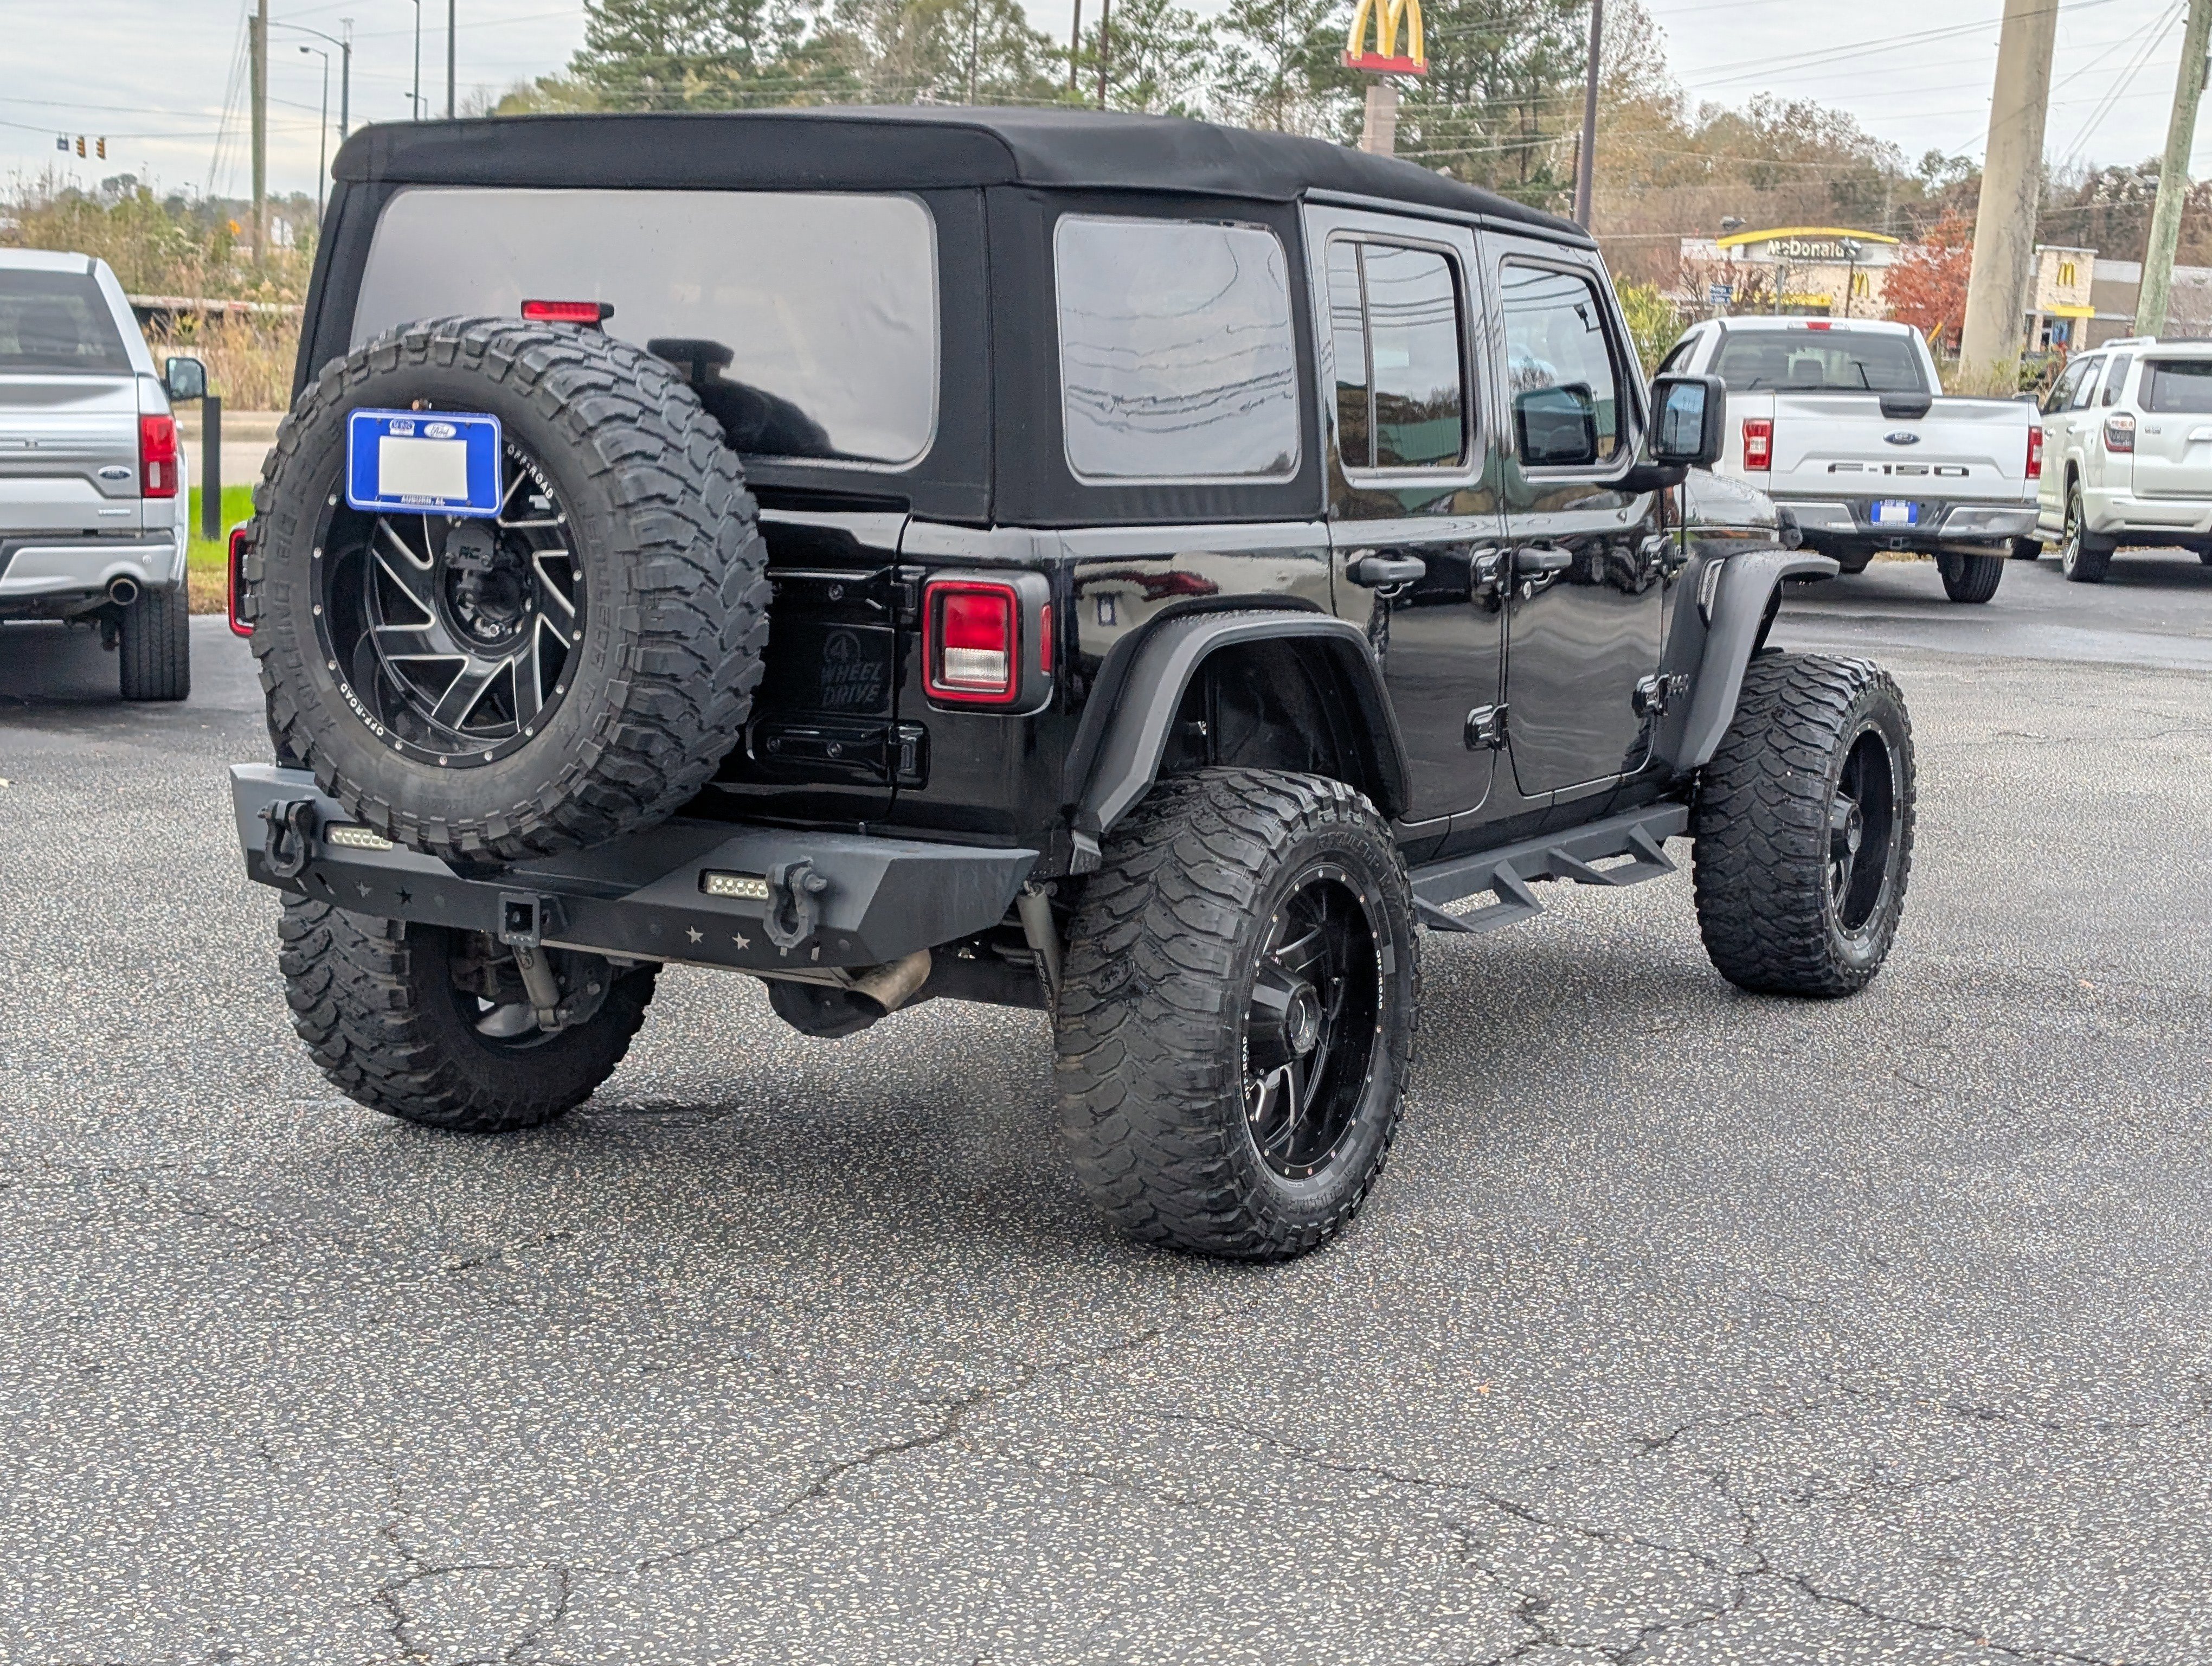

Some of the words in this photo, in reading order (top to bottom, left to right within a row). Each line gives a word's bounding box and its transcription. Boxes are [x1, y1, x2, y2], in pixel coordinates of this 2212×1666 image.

[821, 662, 884, 685] WHEEL
[821, 683, 881, 708] DRIVE
[340, 683, 384, 736] OFF-ROAD
